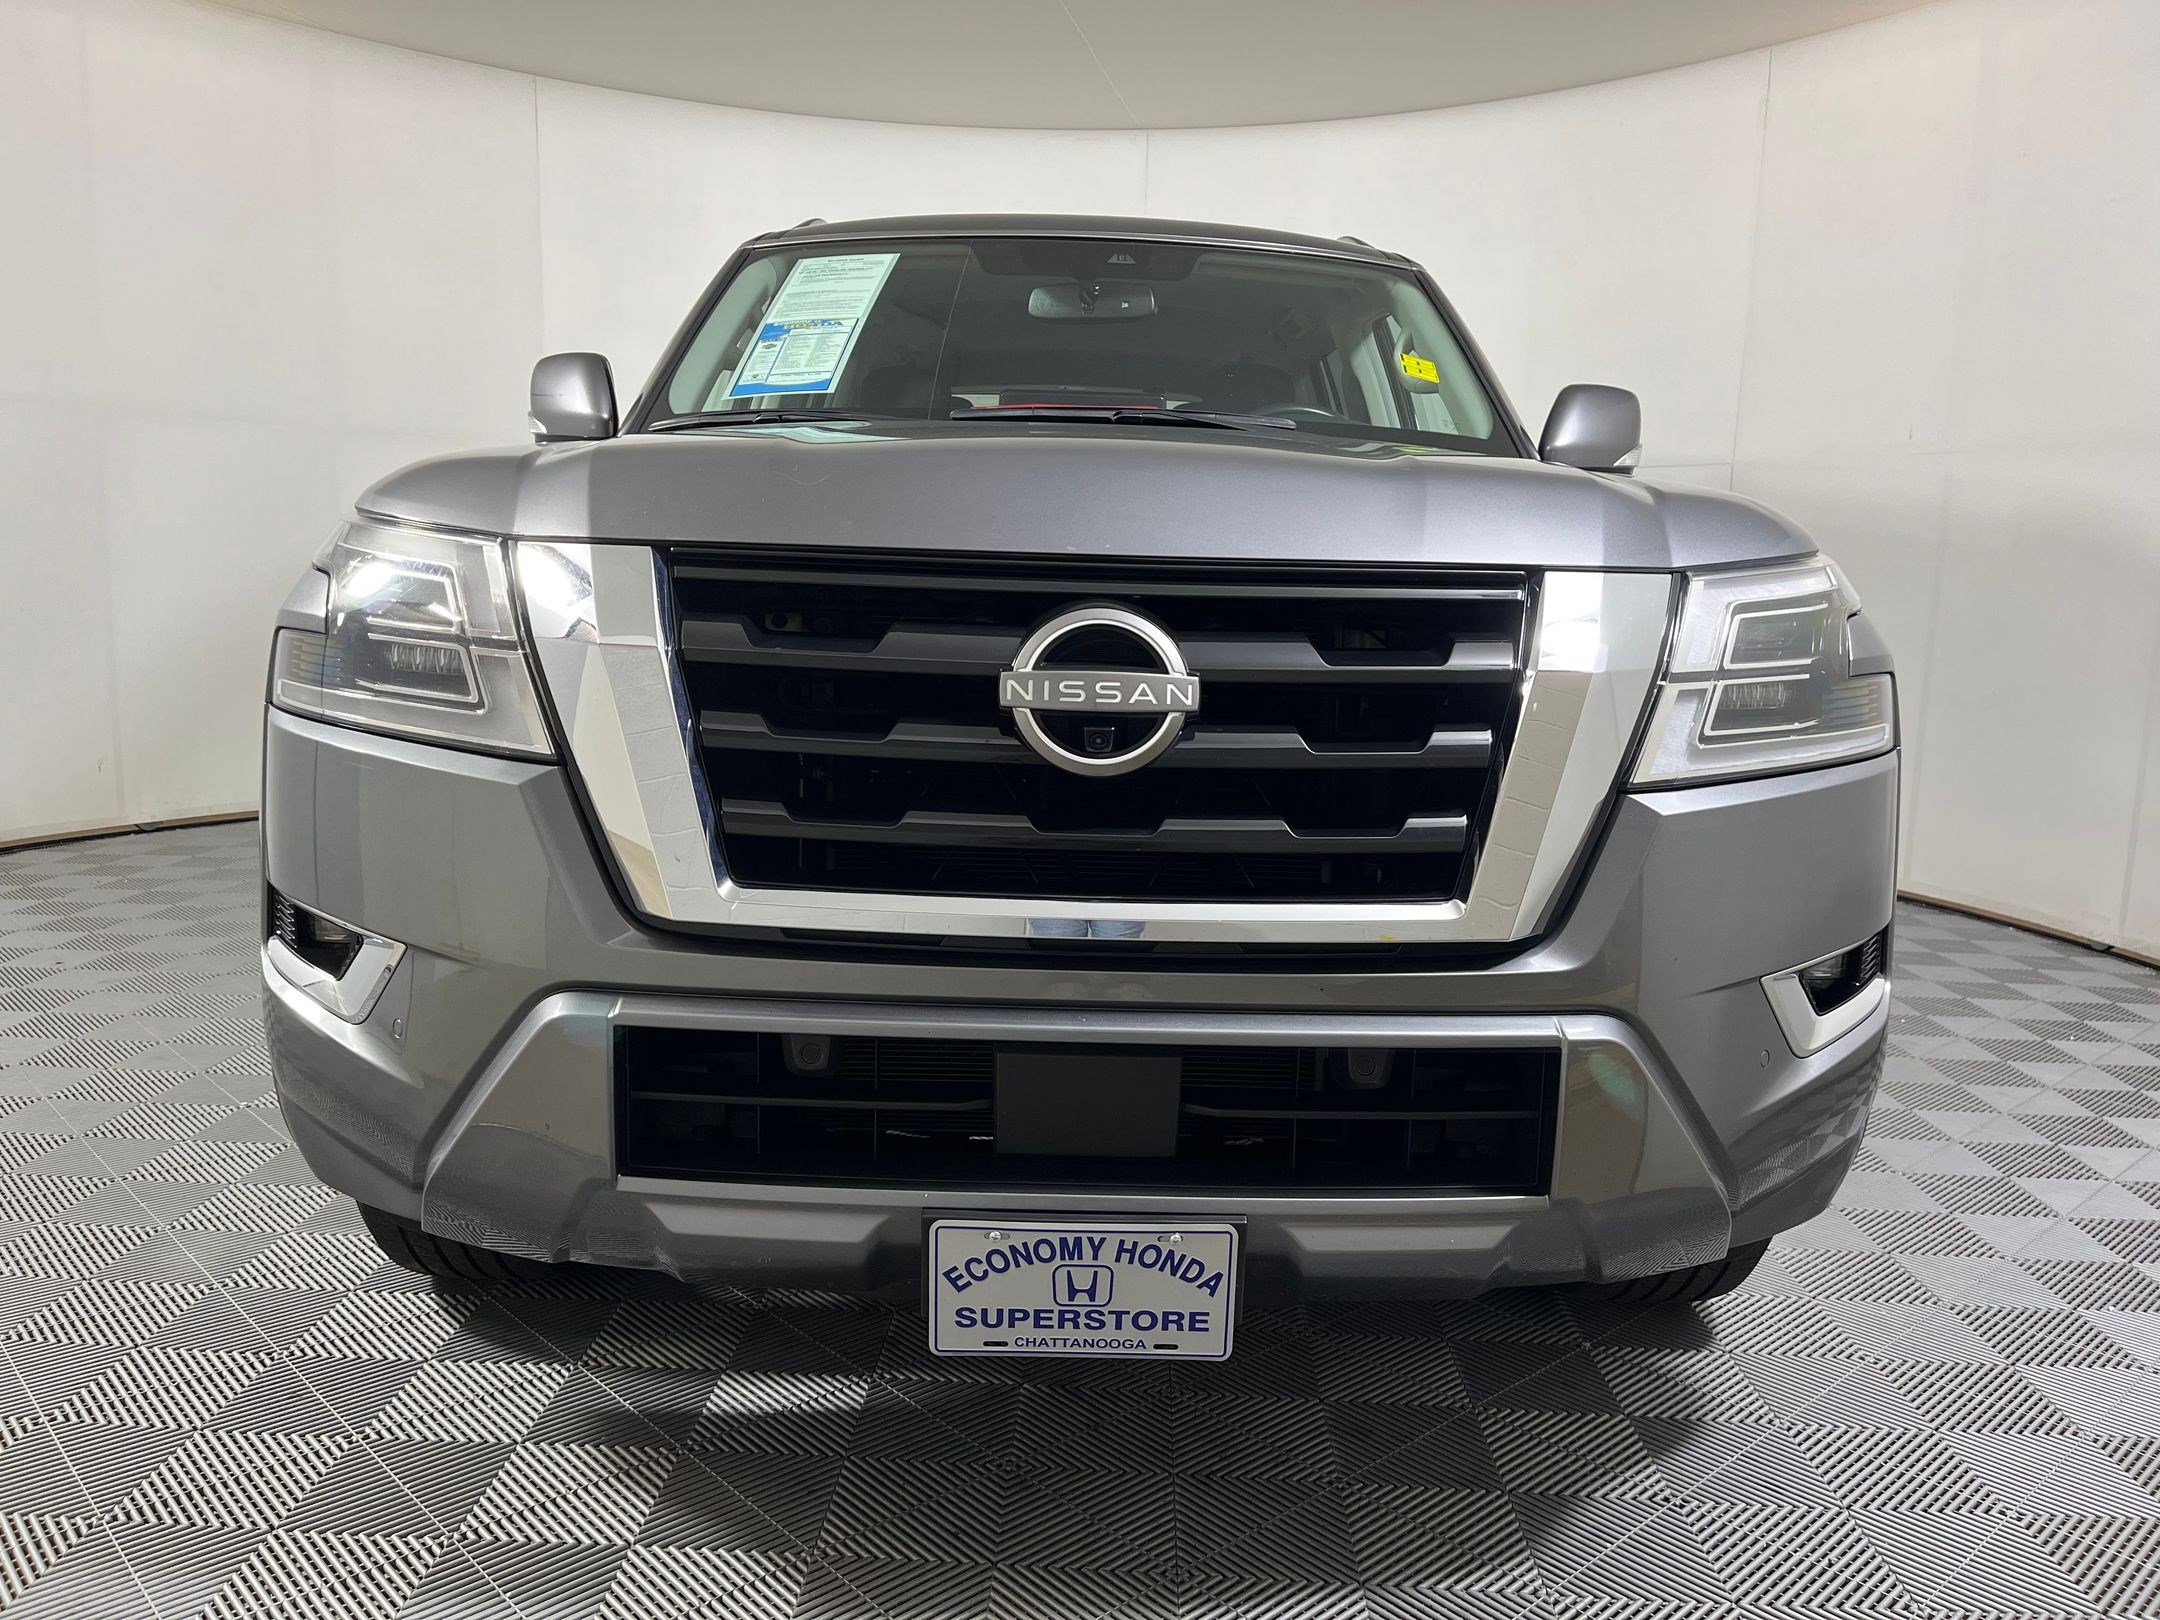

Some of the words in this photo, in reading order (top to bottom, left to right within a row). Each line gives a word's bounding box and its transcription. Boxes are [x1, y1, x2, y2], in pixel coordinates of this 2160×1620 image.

[1006, 679, 1193, 706] NISSAN
[942, 1236, 1107, 1293] ECONOMY
[1114, 1239, 1225, 1298] HONDA
[954, 1306, 1211, 1333] SUPERSTORE
[1014, 1336, 1148, 1350] CHATTANOOGA
